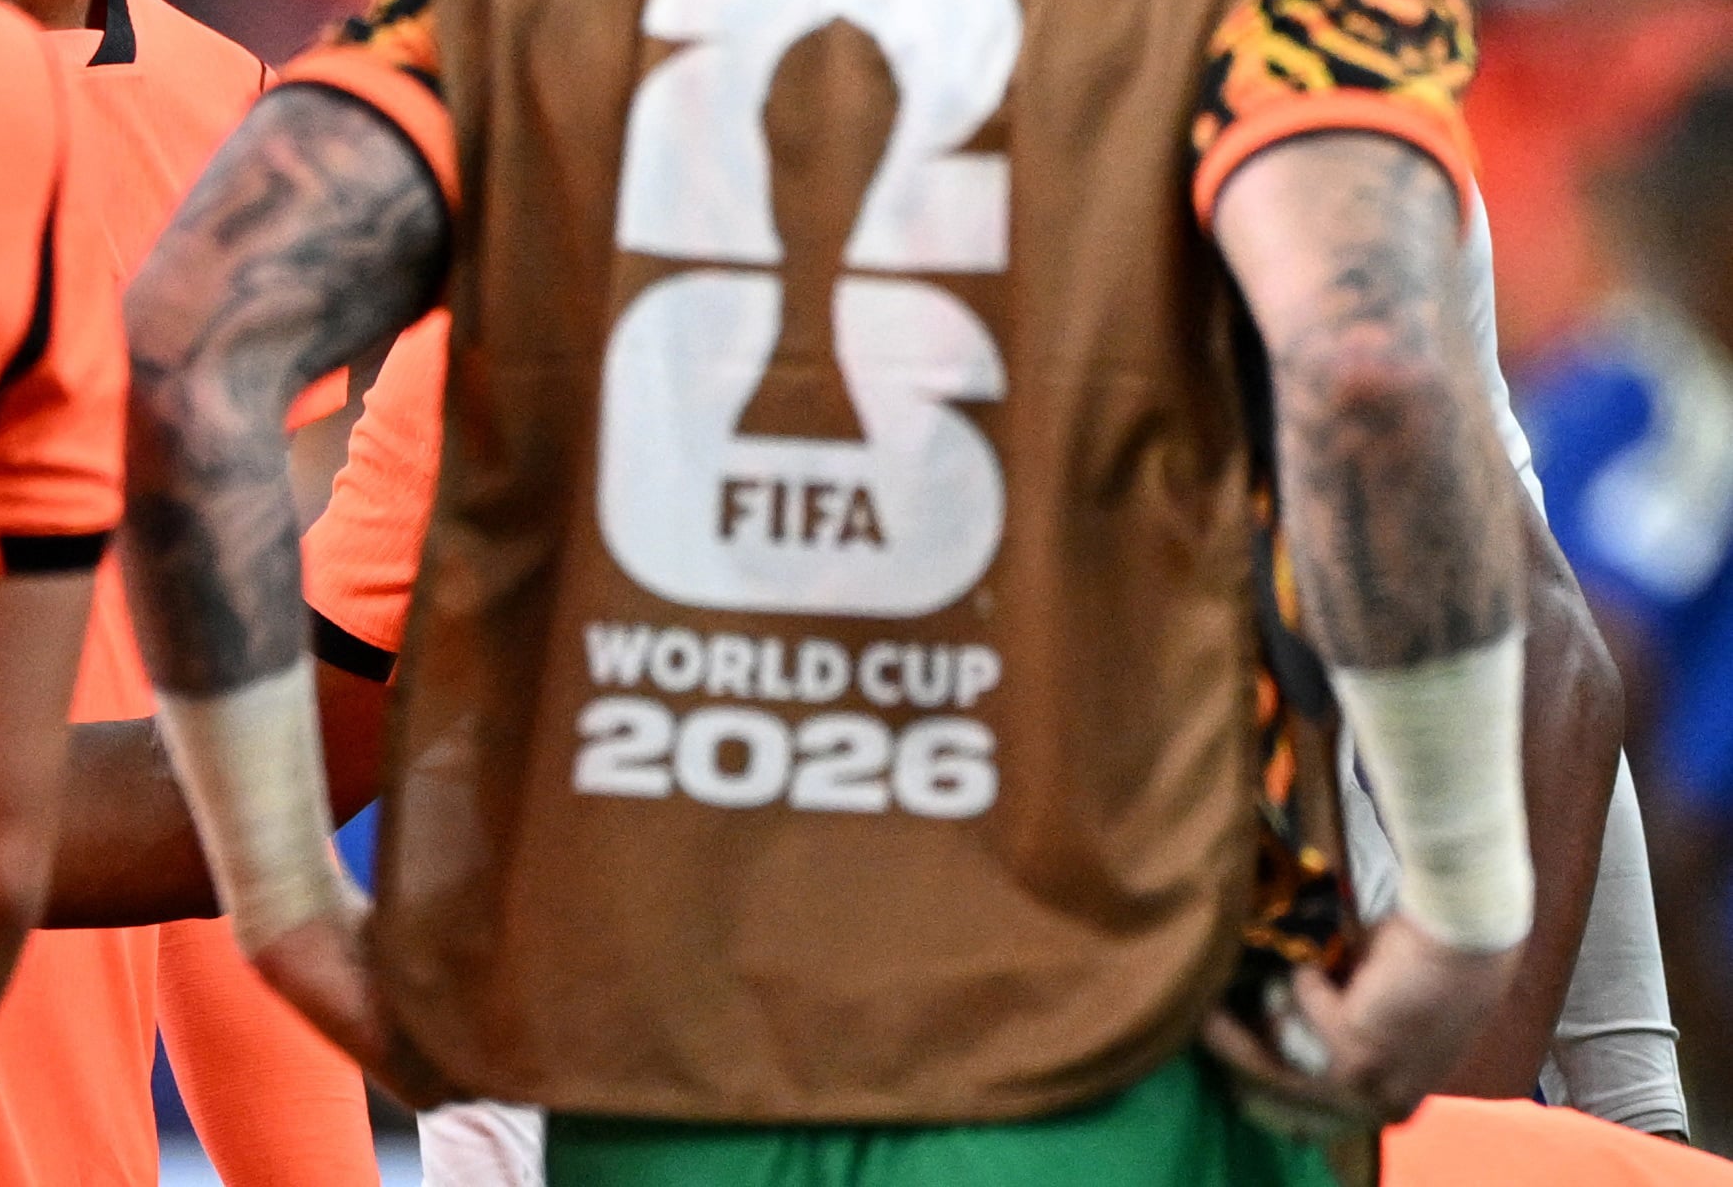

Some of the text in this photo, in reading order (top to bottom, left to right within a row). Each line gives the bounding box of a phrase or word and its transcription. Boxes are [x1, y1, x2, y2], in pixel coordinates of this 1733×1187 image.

[716, 479, 887, 550] FIFA
[586, 623, 1002, 709] WORLD CUP
[572, 697, 1000, 820] 2026
